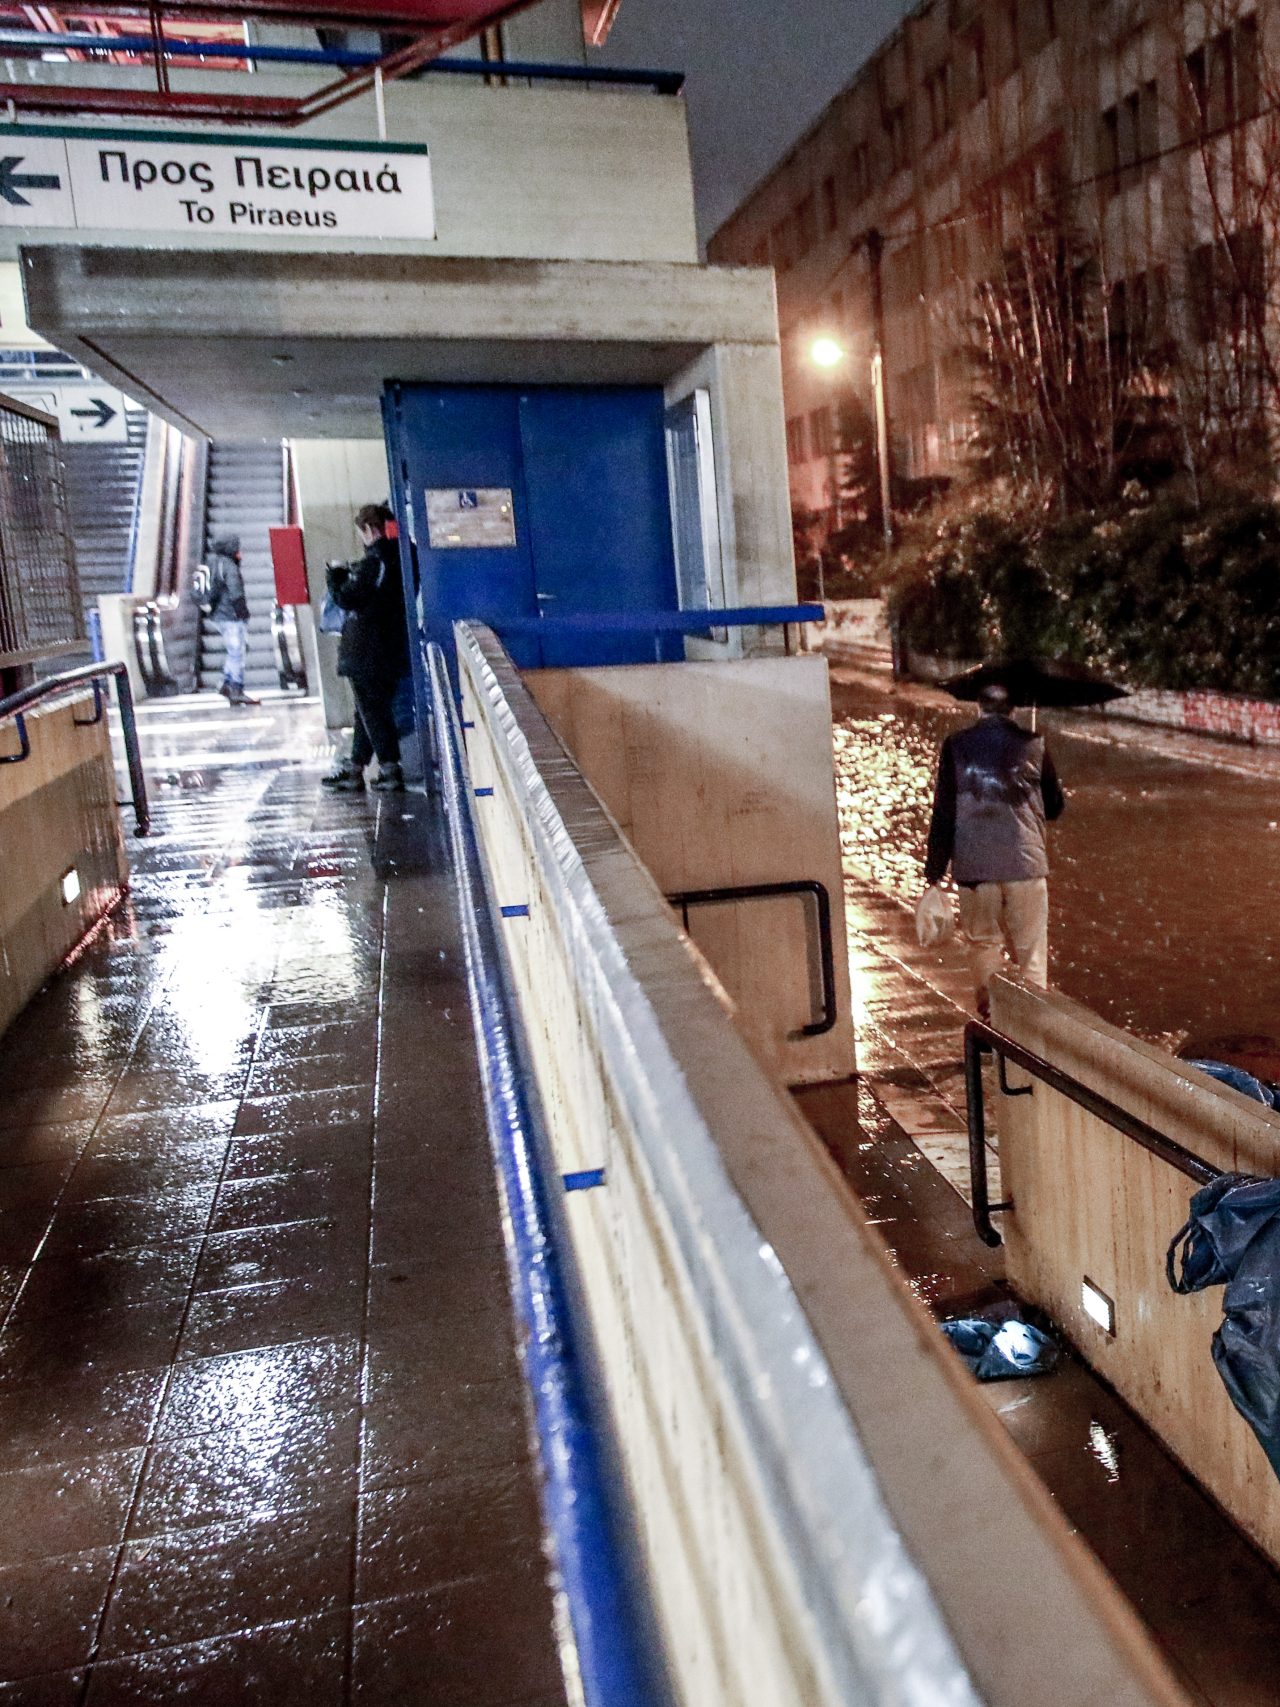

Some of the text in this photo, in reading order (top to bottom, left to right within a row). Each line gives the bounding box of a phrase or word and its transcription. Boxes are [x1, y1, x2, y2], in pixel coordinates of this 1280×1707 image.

[98, 150, 402, 198] Προς Πειραιά
[179, 200, 338, 228] To Piraeus
